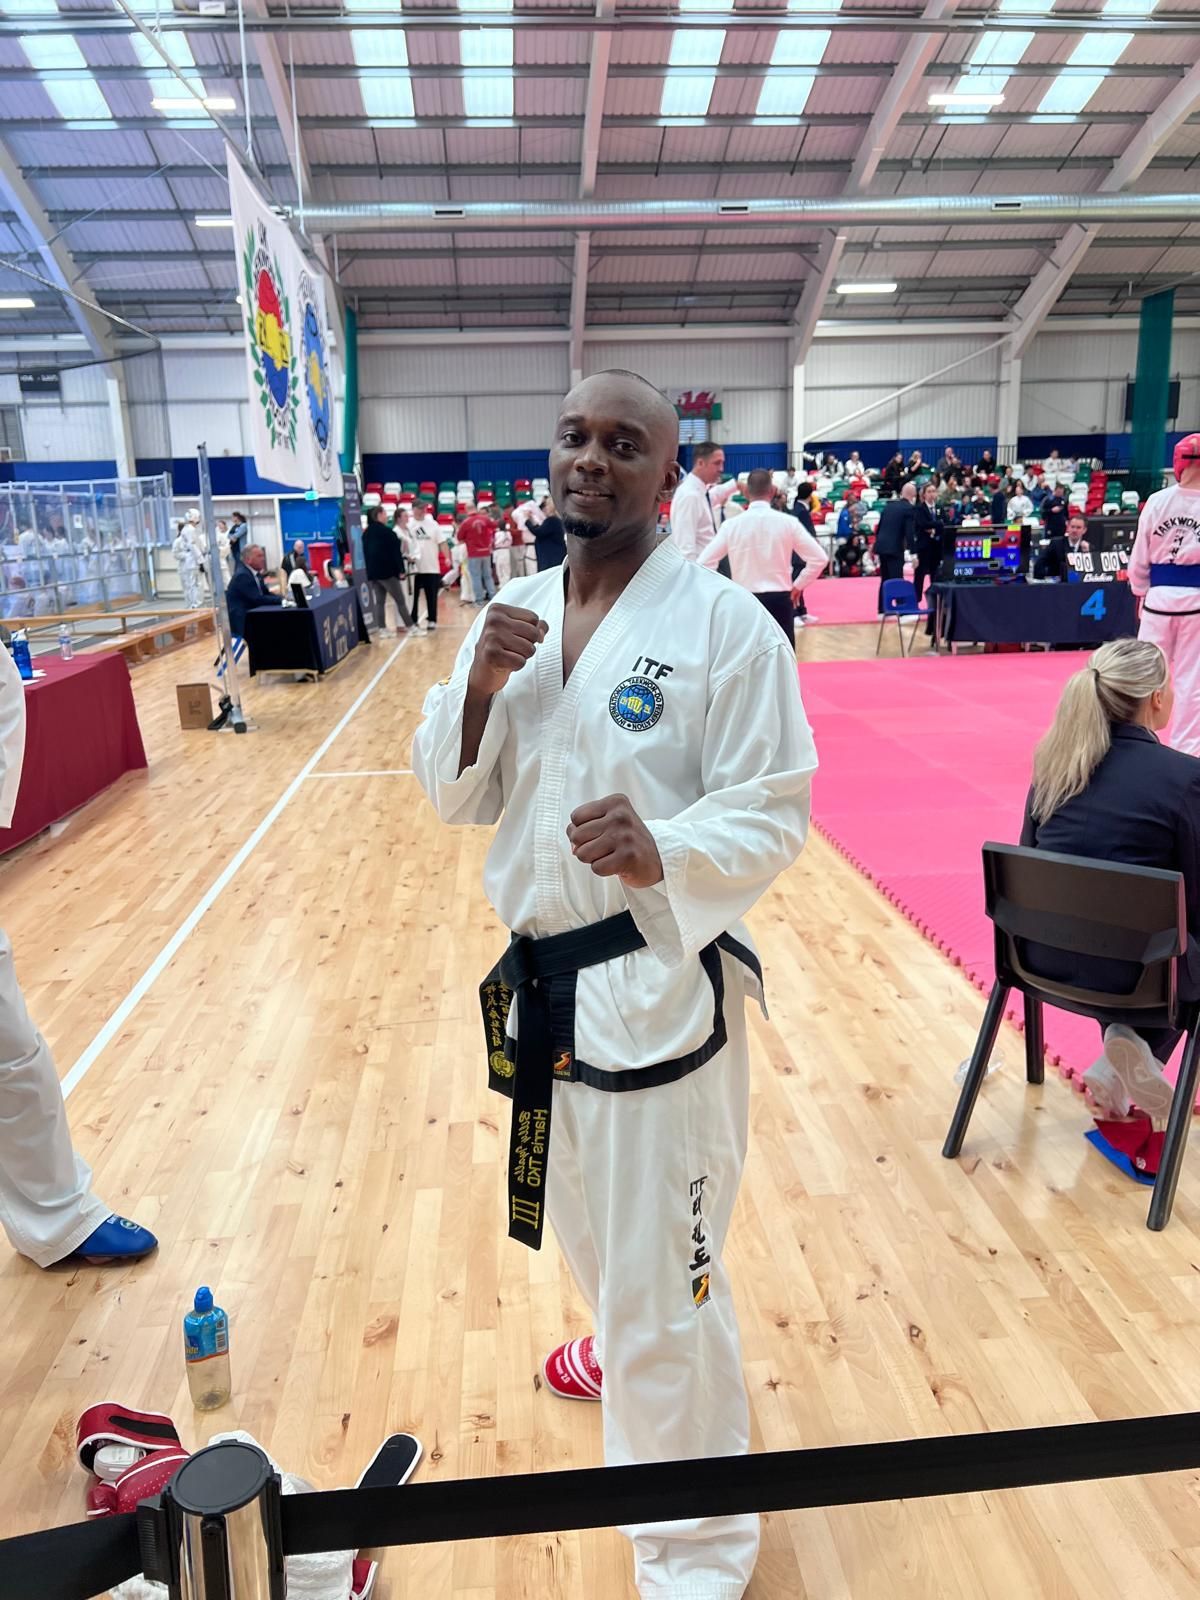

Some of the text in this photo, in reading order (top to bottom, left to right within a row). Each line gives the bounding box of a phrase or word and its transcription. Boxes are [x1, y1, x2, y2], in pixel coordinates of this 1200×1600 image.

[1080, 589, 1106, 621] 4
[632, 656, 673, 680] ITF
[632, 704, 662, 730] FEDERATION
[689, 1175, 708, 1197] ITF
